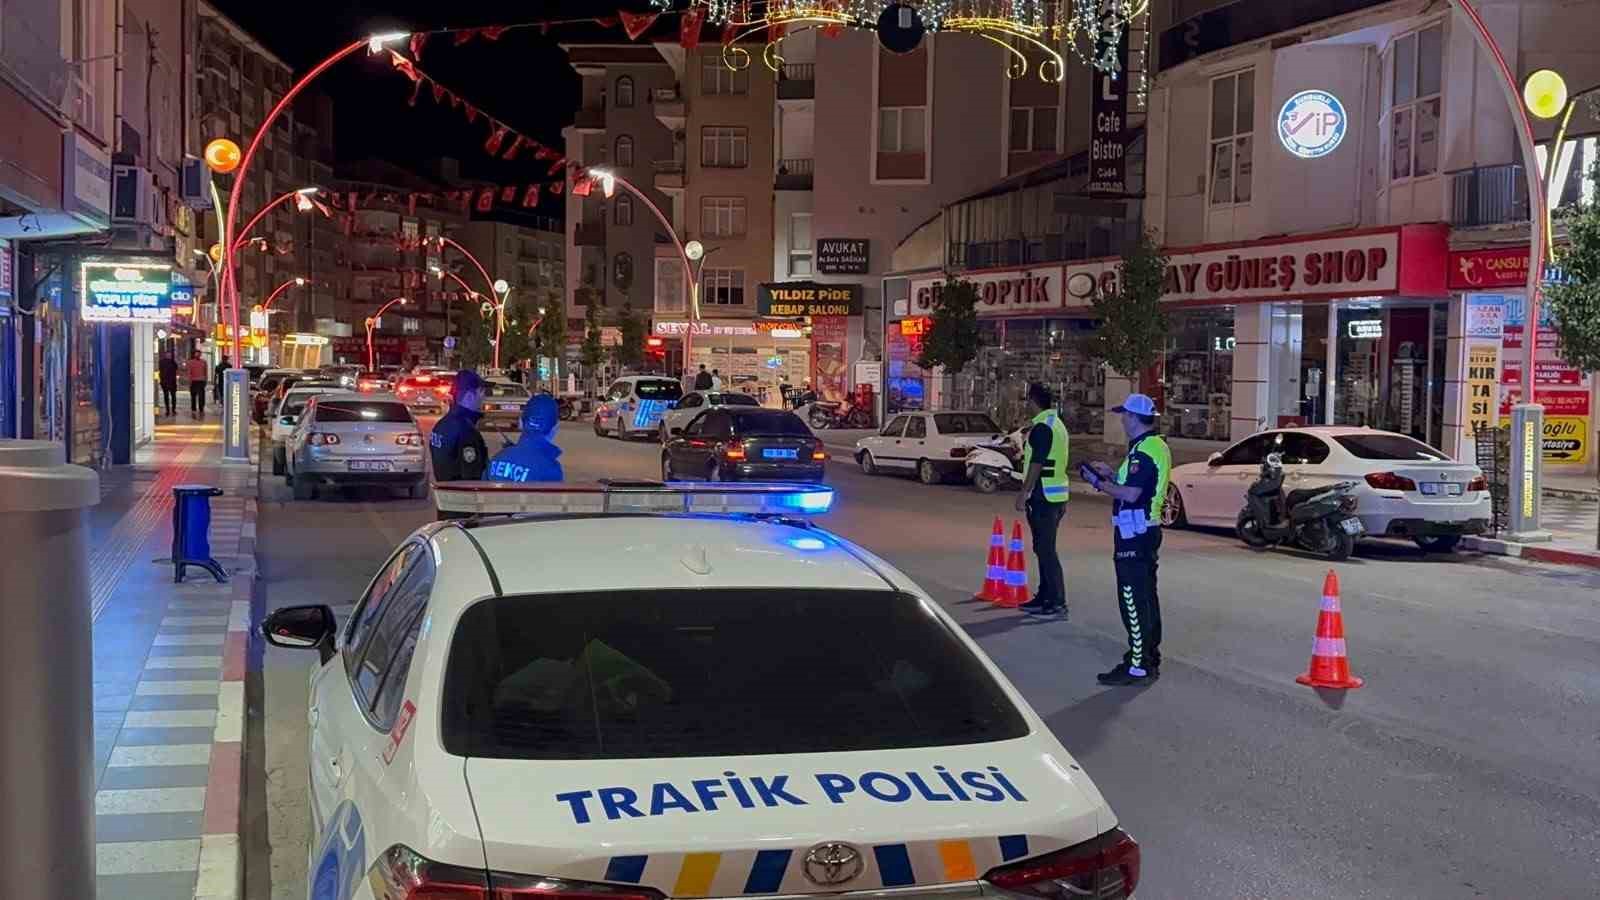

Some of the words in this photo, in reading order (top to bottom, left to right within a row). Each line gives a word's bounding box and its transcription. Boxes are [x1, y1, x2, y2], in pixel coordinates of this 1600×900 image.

[1097, 111, 1120, 133] Cafe
[1092, 138, 1124, 160] Bistro
[822, 242, 864, 255] AVUKAT
[1205, 254, 1296, 292] GÜNEŞ
[1303, 248, 1387, 279] SHOP
[770, 289, 816, 301] YILDIZ
[982, 272, 1051, 306] OPTİK
[770, 304, 805, 315] KEBAP
[808, 304, 849, 315] SALONU
[1472, 384, 1490, 397] TA
[556, 771, 808, 824] TRAFİK
[814, 765, 1029, 804] POLİSİ
